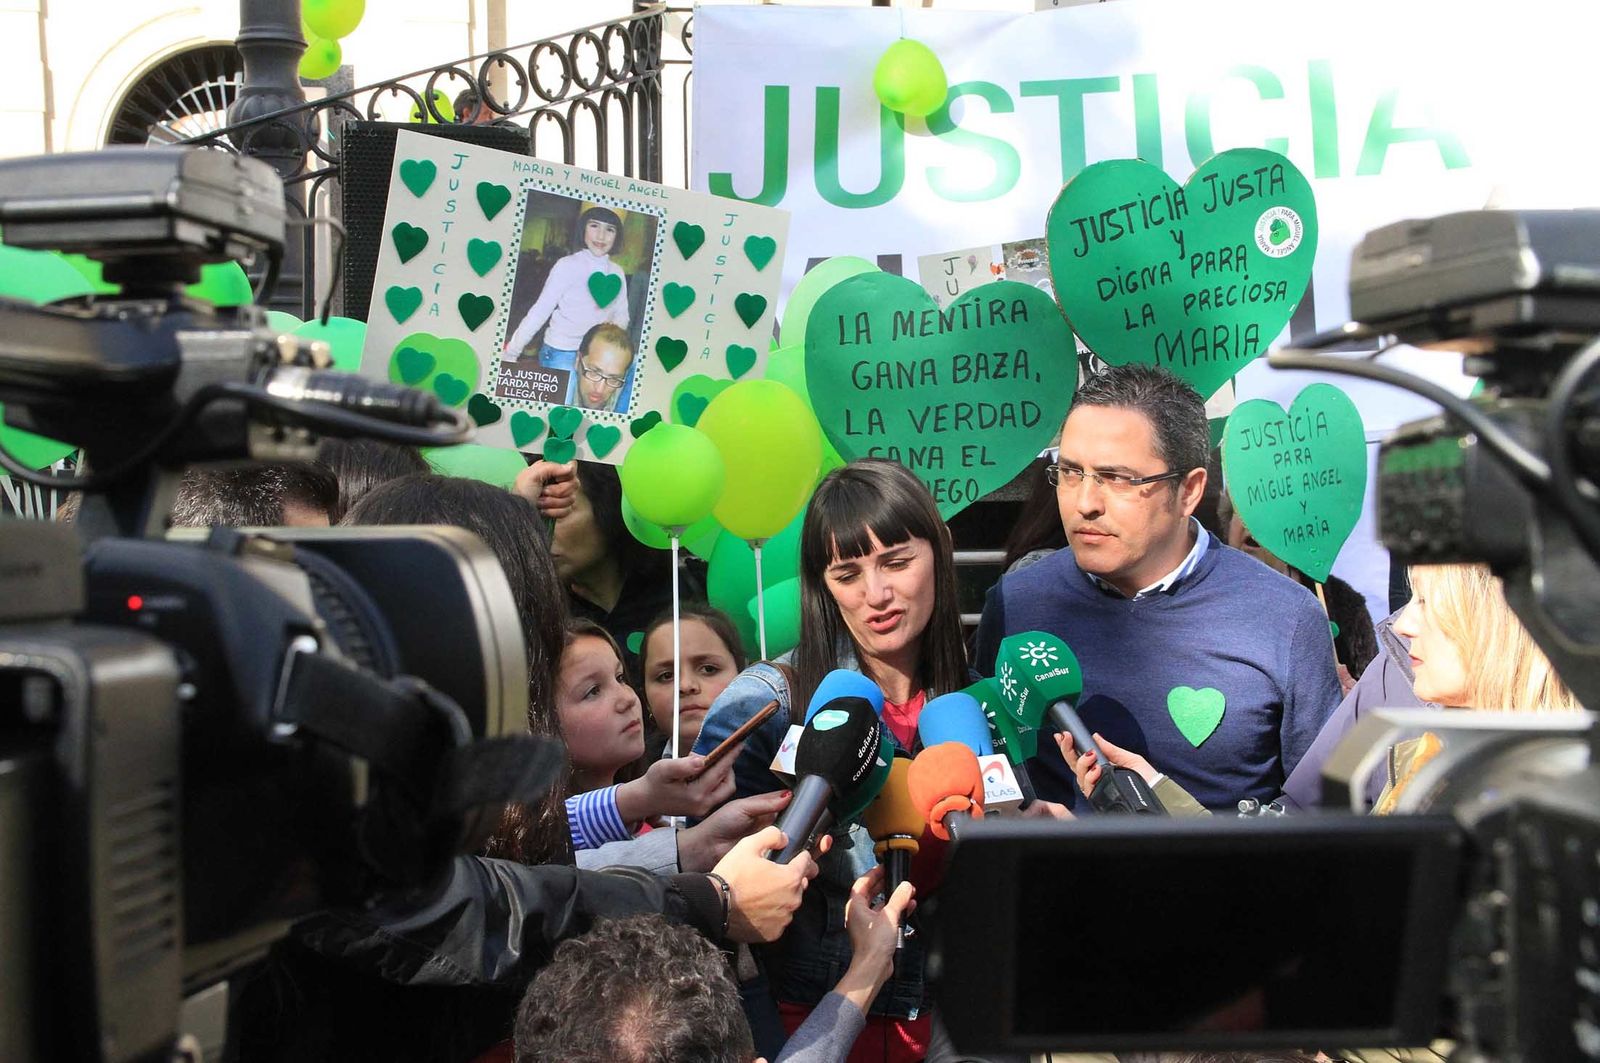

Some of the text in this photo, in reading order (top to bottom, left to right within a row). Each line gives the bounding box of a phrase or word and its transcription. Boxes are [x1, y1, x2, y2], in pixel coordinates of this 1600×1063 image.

[707, 58, 1473, 209] JUSTICIA
[513, 160, 669, 199] MARIA Y MIGUEL ANGEL
[1070, 163, 1286, 258] JUSTICIA JUSTA
[1096, 244, 1249, 302] DIGNA PARA
[1124, 303, 1157, 331] LA
[1183, 274, 1288, 317] PRECIOSA
[838, 297, 1029, 345] LA MENTIRA
[1154, 323, 1260, 368] MARIA
[497, 376, 558, 393] TARDA PERO
[499, 367, 559, 384] LA JUSTICIA
[851, 358, 938, 391] GANA
[504, 387, 536, 399] LLEGA
[845, 400, 1042, 436] LA VERDAD
[1241, 408, 1329, 450] JUSTICIA
[961, 445, 996, 467] EL
[1273, 447, 1313, 470] PARA
[1247, 468, 1342, 506] MIGUE ANGEL
[1300, 501, 1308, 515] Y
[1283, 516, 1330, 547] MARIA
[985, 787, 1017, 799] TLAS
